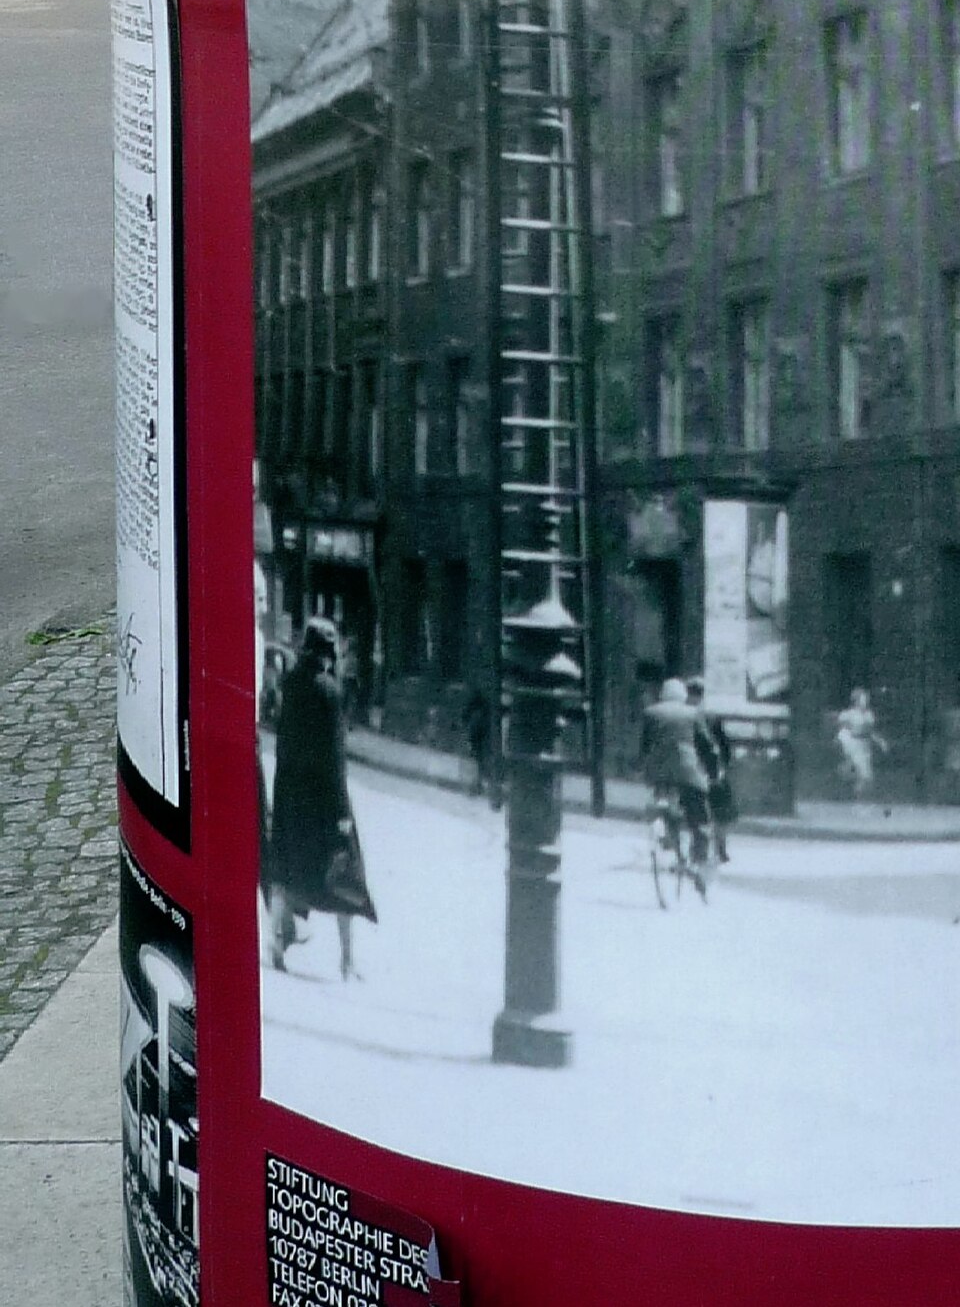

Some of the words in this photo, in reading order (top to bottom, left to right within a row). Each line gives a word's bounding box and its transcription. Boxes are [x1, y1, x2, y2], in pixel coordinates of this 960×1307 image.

[267, 1157, 349, 1212] STIFTUNG
[267, 1182, 394, 1255] TOPOGRAPHIE
[268, 1208, 376, 1273] BUDAPESTER
[379, 1257, 430, 1293] STRA
[269, 1235, 317, 1271] 10787
[321, 1257, 380, 1301] BERLIN
[269, 1257, 343, 1307] TELEFON
[272, 1282, 303, 1307] FAX
